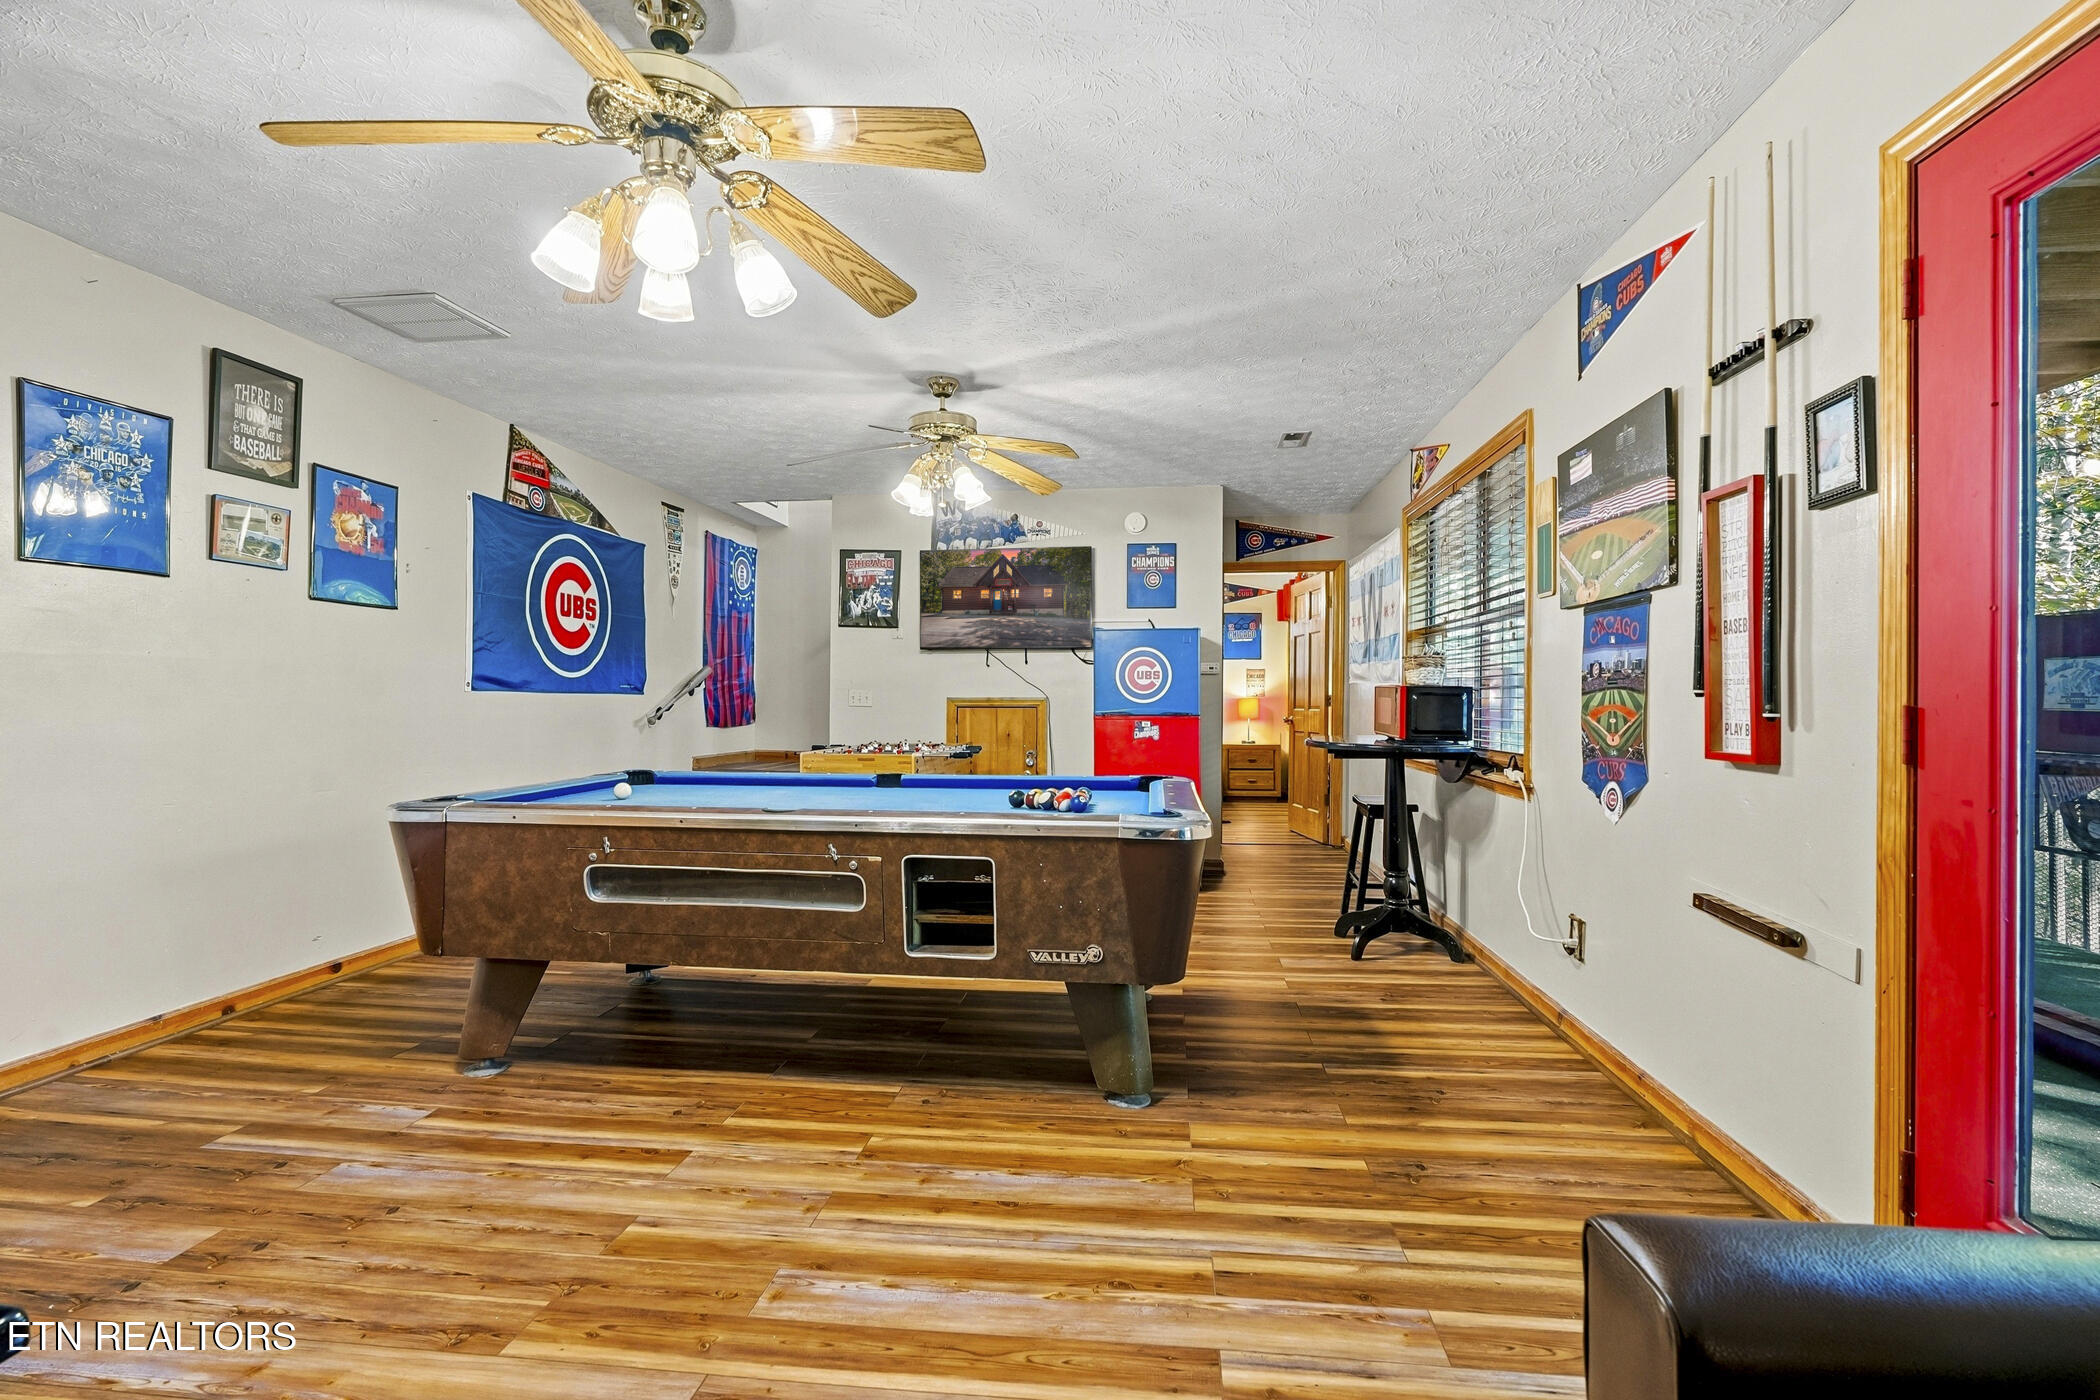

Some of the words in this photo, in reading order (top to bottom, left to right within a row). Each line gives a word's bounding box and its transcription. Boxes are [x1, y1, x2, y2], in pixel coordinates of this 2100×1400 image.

[1618, 264, 1642, 291] CHICAGO
[1616, 274, 1644, 310] CUBS
[234, 384, 271, 409] THERE
[274, 395, 283, 413] IS
[63, 398, 147, 425] DIVISION
[235, 403, 245, 419] BUT
[240, 423, 256, 436] THAT
[257, 428, 275, 442] GAME
[276, 433, 282, 443] IS
[83, 446, 128, 467] CHICAGO
[233, 434, 282, 461] BASEBALL
[847, 559, 894, 570] CHICAGO
[1131, 556, 1175, 568] CHAMPIONS
[545, 562, 597, 650] CUBS
[1590, 616, 1639, 644] CHICAGO
[1127, 658, 1160, 692] CUBS
[1724, 722, 1743, 736] PLAY
[1598, 761, 1627, 781] CUBS
[1029, 951, 1089, 963] VALLEY
